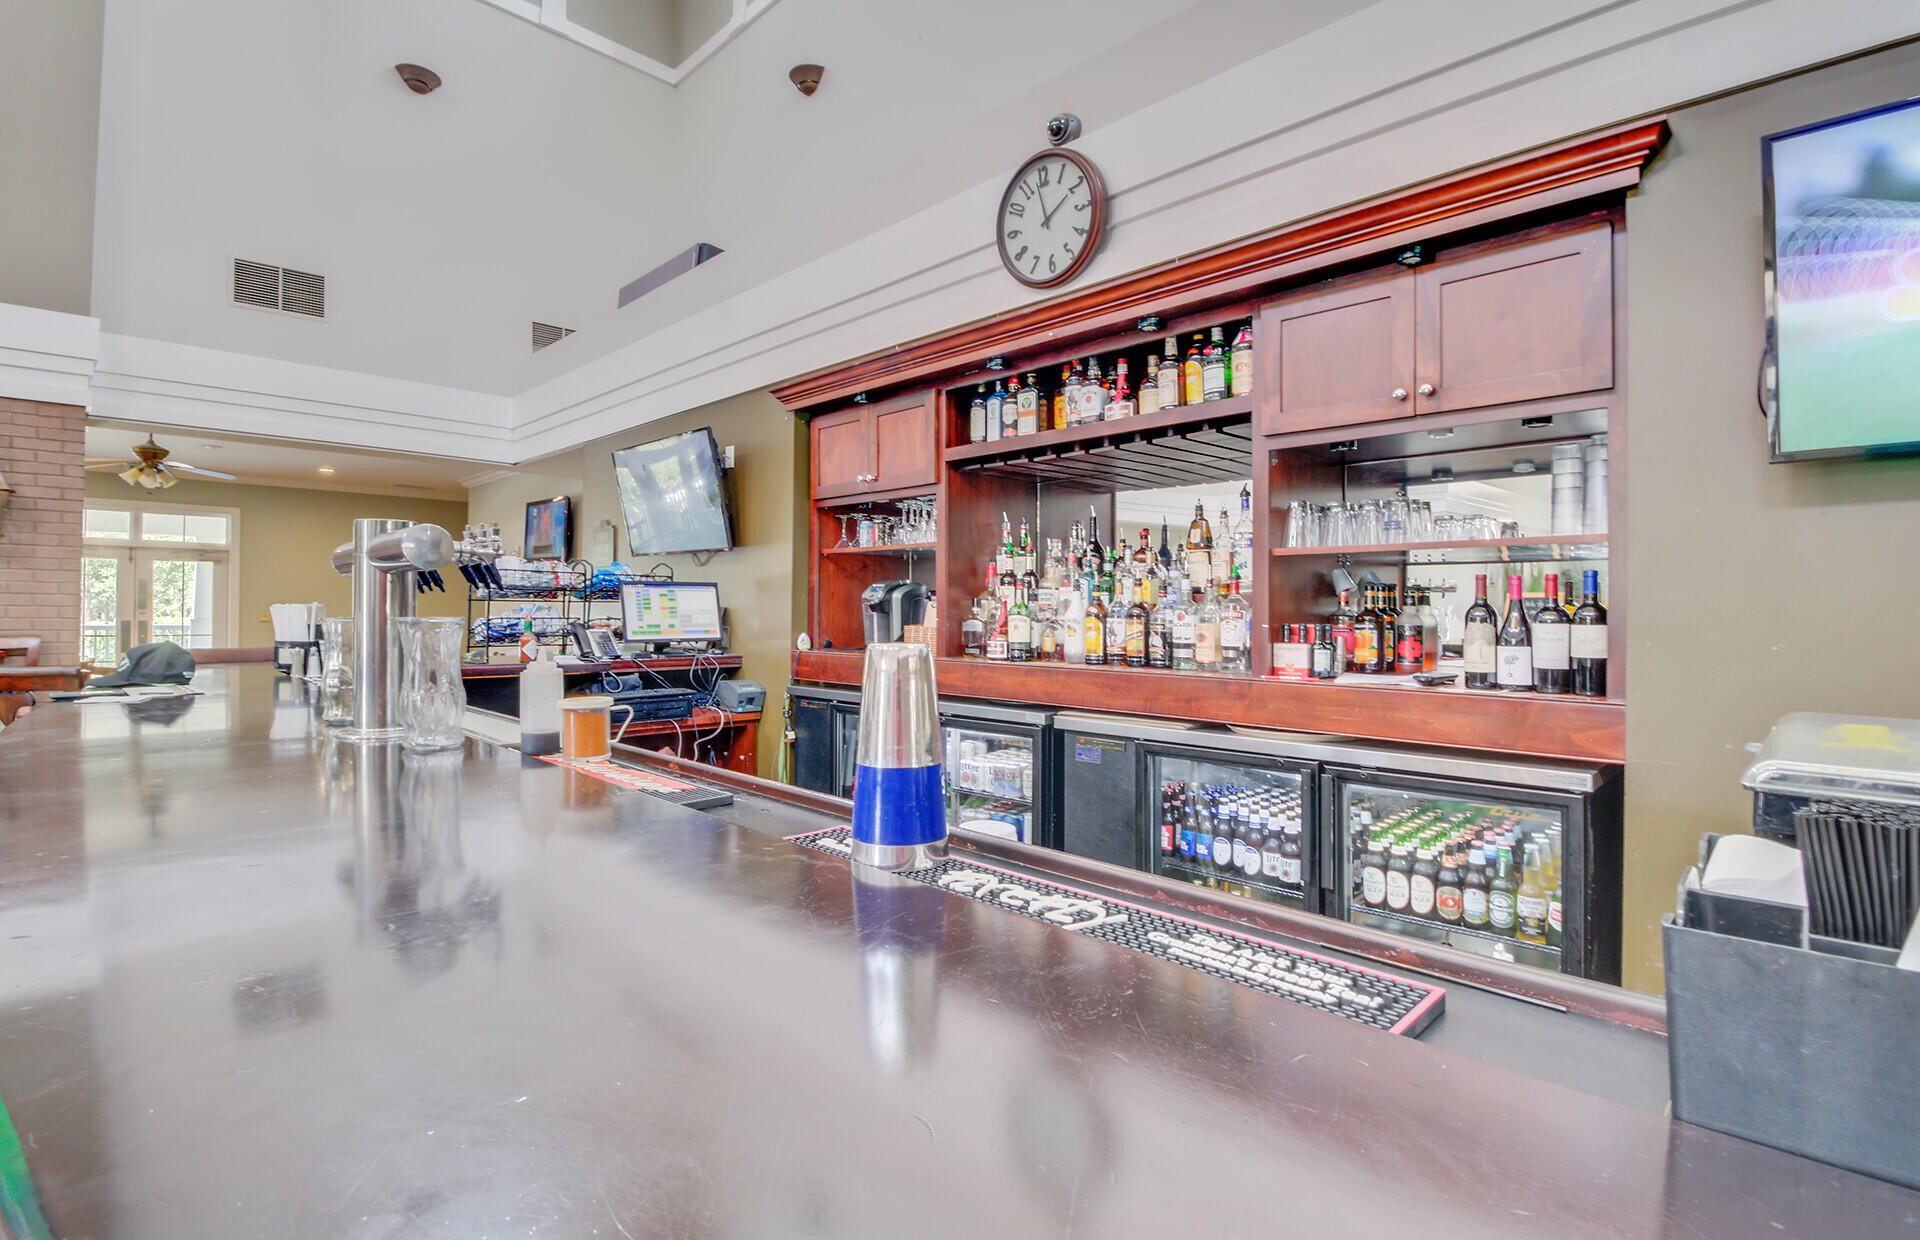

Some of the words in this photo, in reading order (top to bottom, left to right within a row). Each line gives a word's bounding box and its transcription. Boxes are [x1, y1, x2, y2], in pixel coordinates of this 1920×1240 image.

[1037, 165, 1050, 188] 12
[1056, 163, 1066, 184] 1
[1019, 180, 1035, 201] 11
[1068, 175, 1084, 194] 2
[1008, 202, 1025, 219] 10
[1074, 199, 1092, 212] 3
[1007, 229, 1023, 240] 9
[1072, 226, 1089, 237] 4
[1014, 245, 1029, 262] 8
[1063, 242, 1076, 261] 5
[1030, 255, 1041, 275] 7
[1048, 253, 1057, 274] 6
